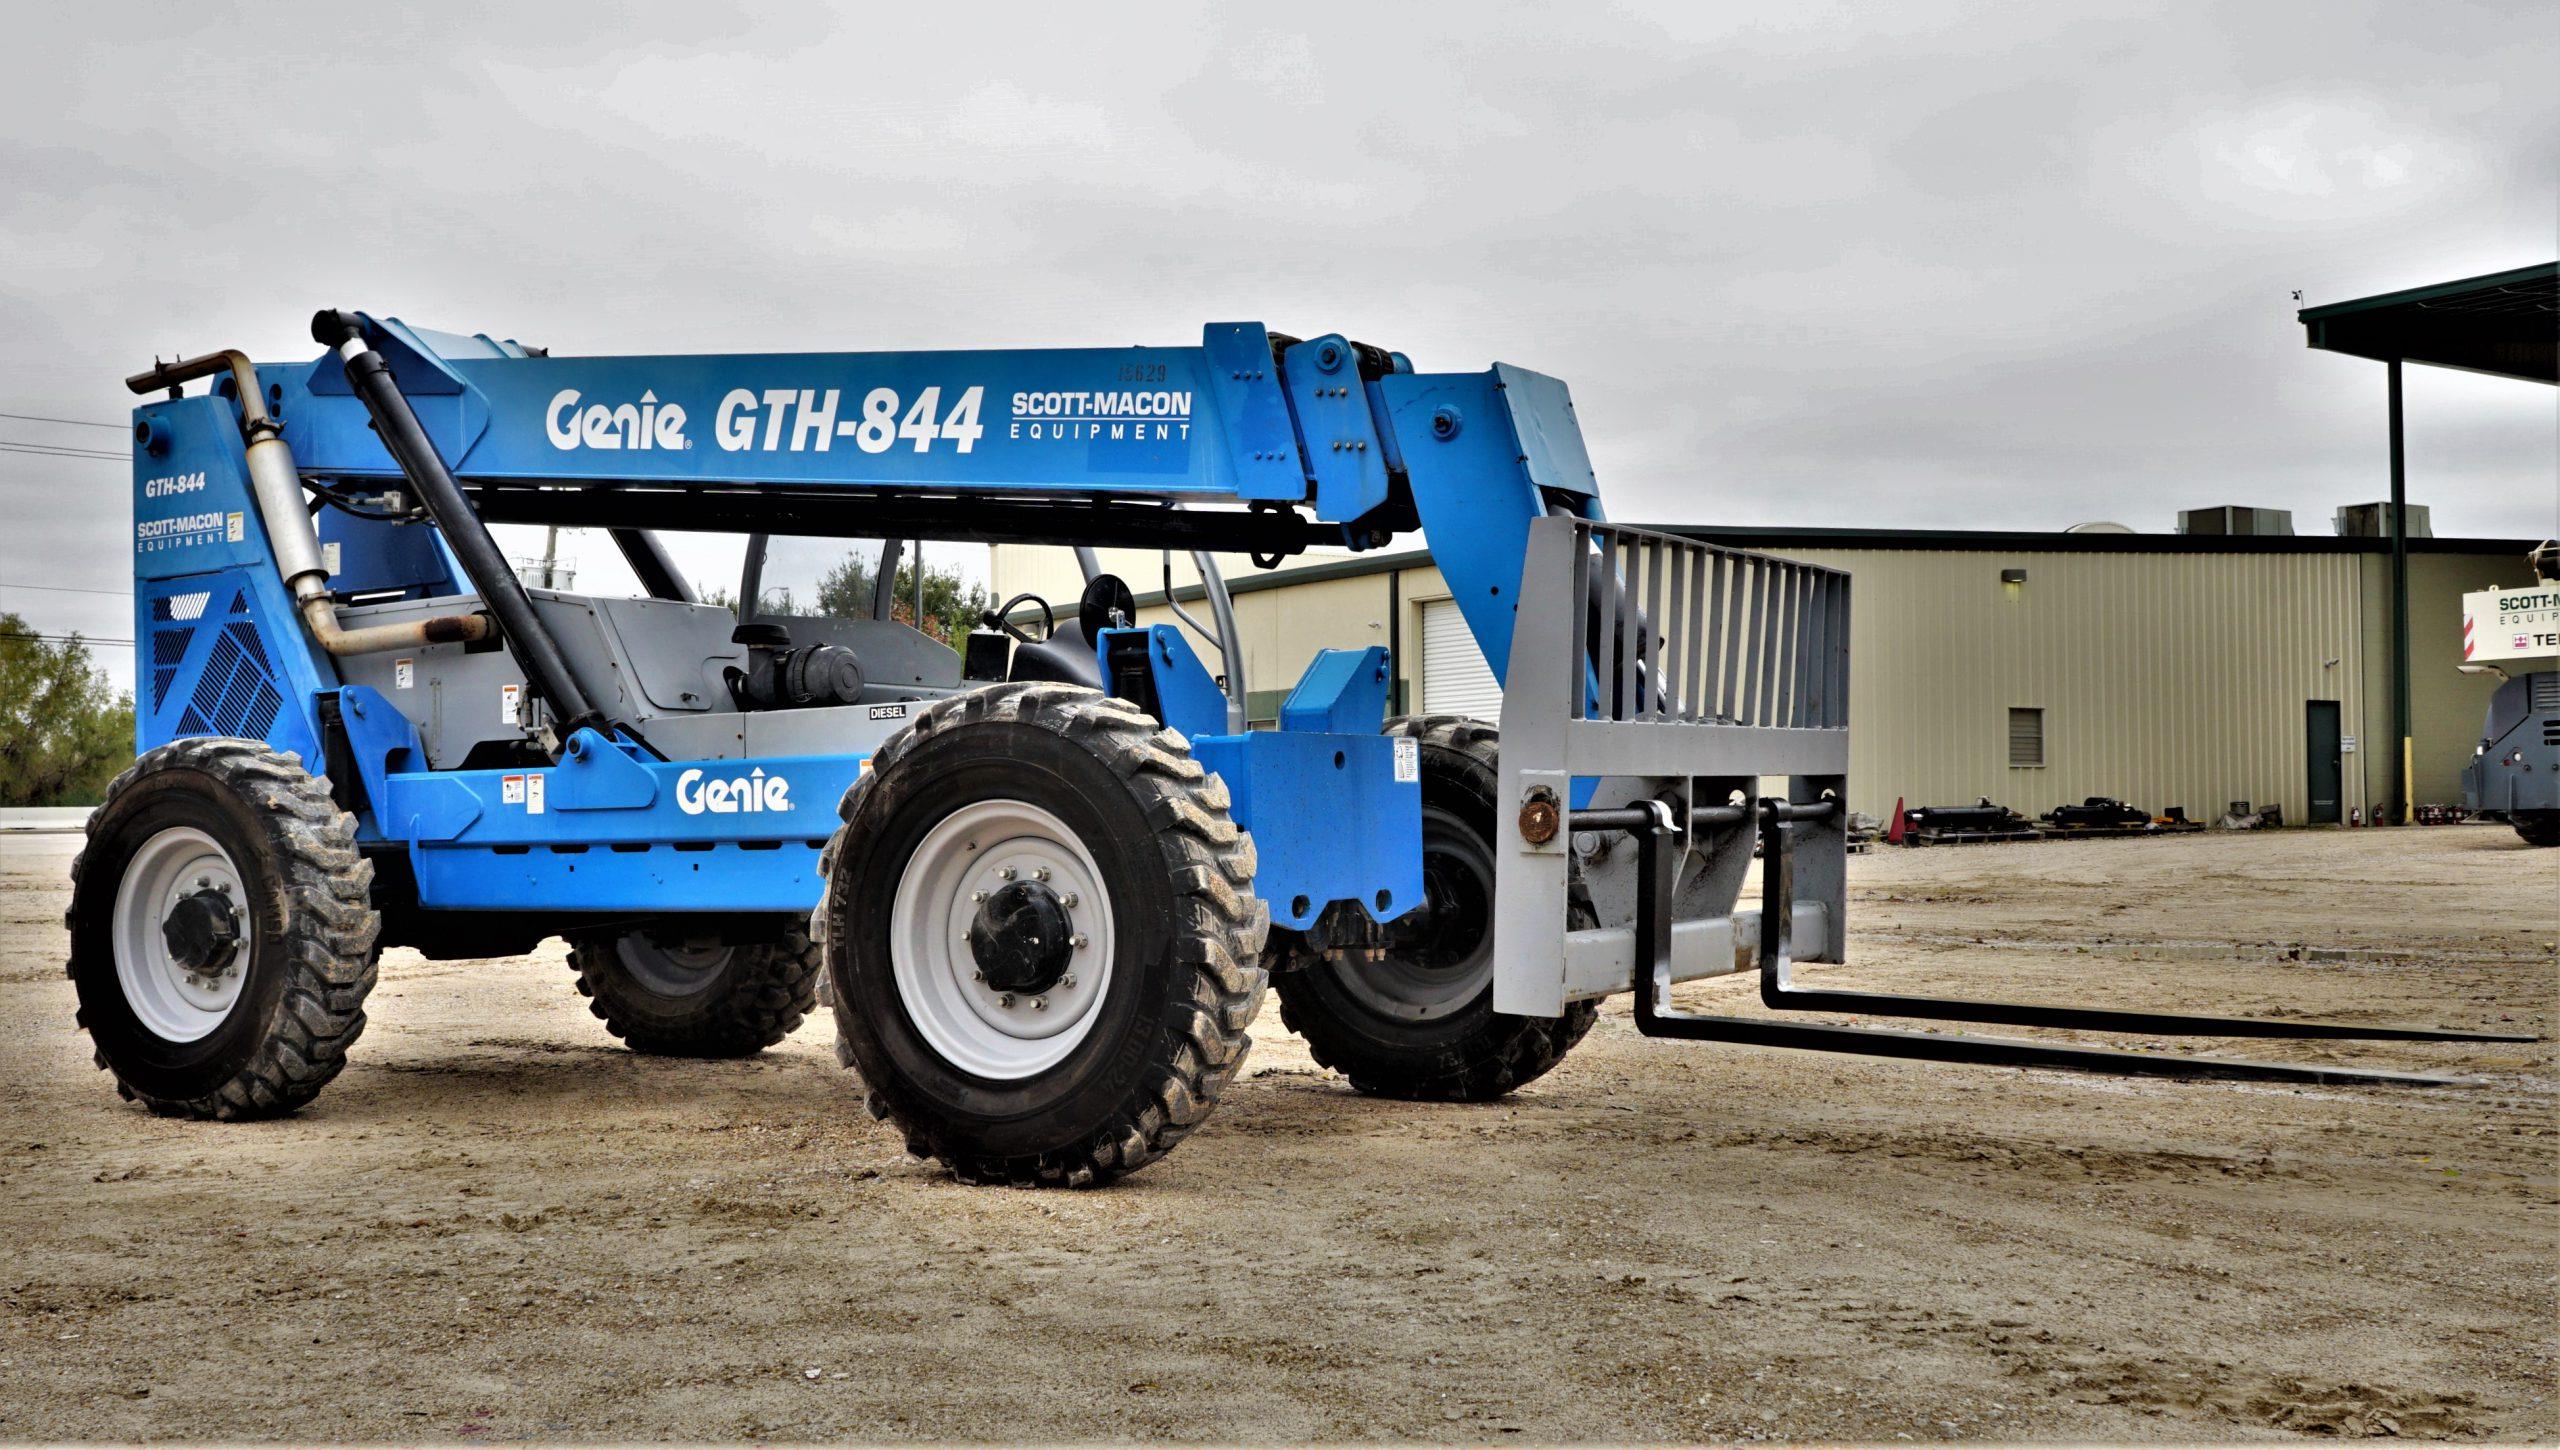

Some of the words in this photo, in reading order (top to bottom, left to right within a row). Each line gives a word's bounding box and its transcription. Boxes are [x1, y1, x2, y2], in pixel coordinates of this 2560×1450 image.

[1012, 391, 1192, 416] SCOTT-MACON
[546, 388, 688, 451] Genie
[715, 386, 984, 454] GTH-844
[1010, 423, 1190, 440] EQUIPMENT
[145, 471, 206, 498] GTH-844
[137, 511, 224, 538] SCOTT-MACON
[137, 532, 224, 553] EQUIPMENT
[2533, 633, 2560, 646] TE
[870, 706, 906, 719] DIESEL
[676, 766, 790, 816] Genie
